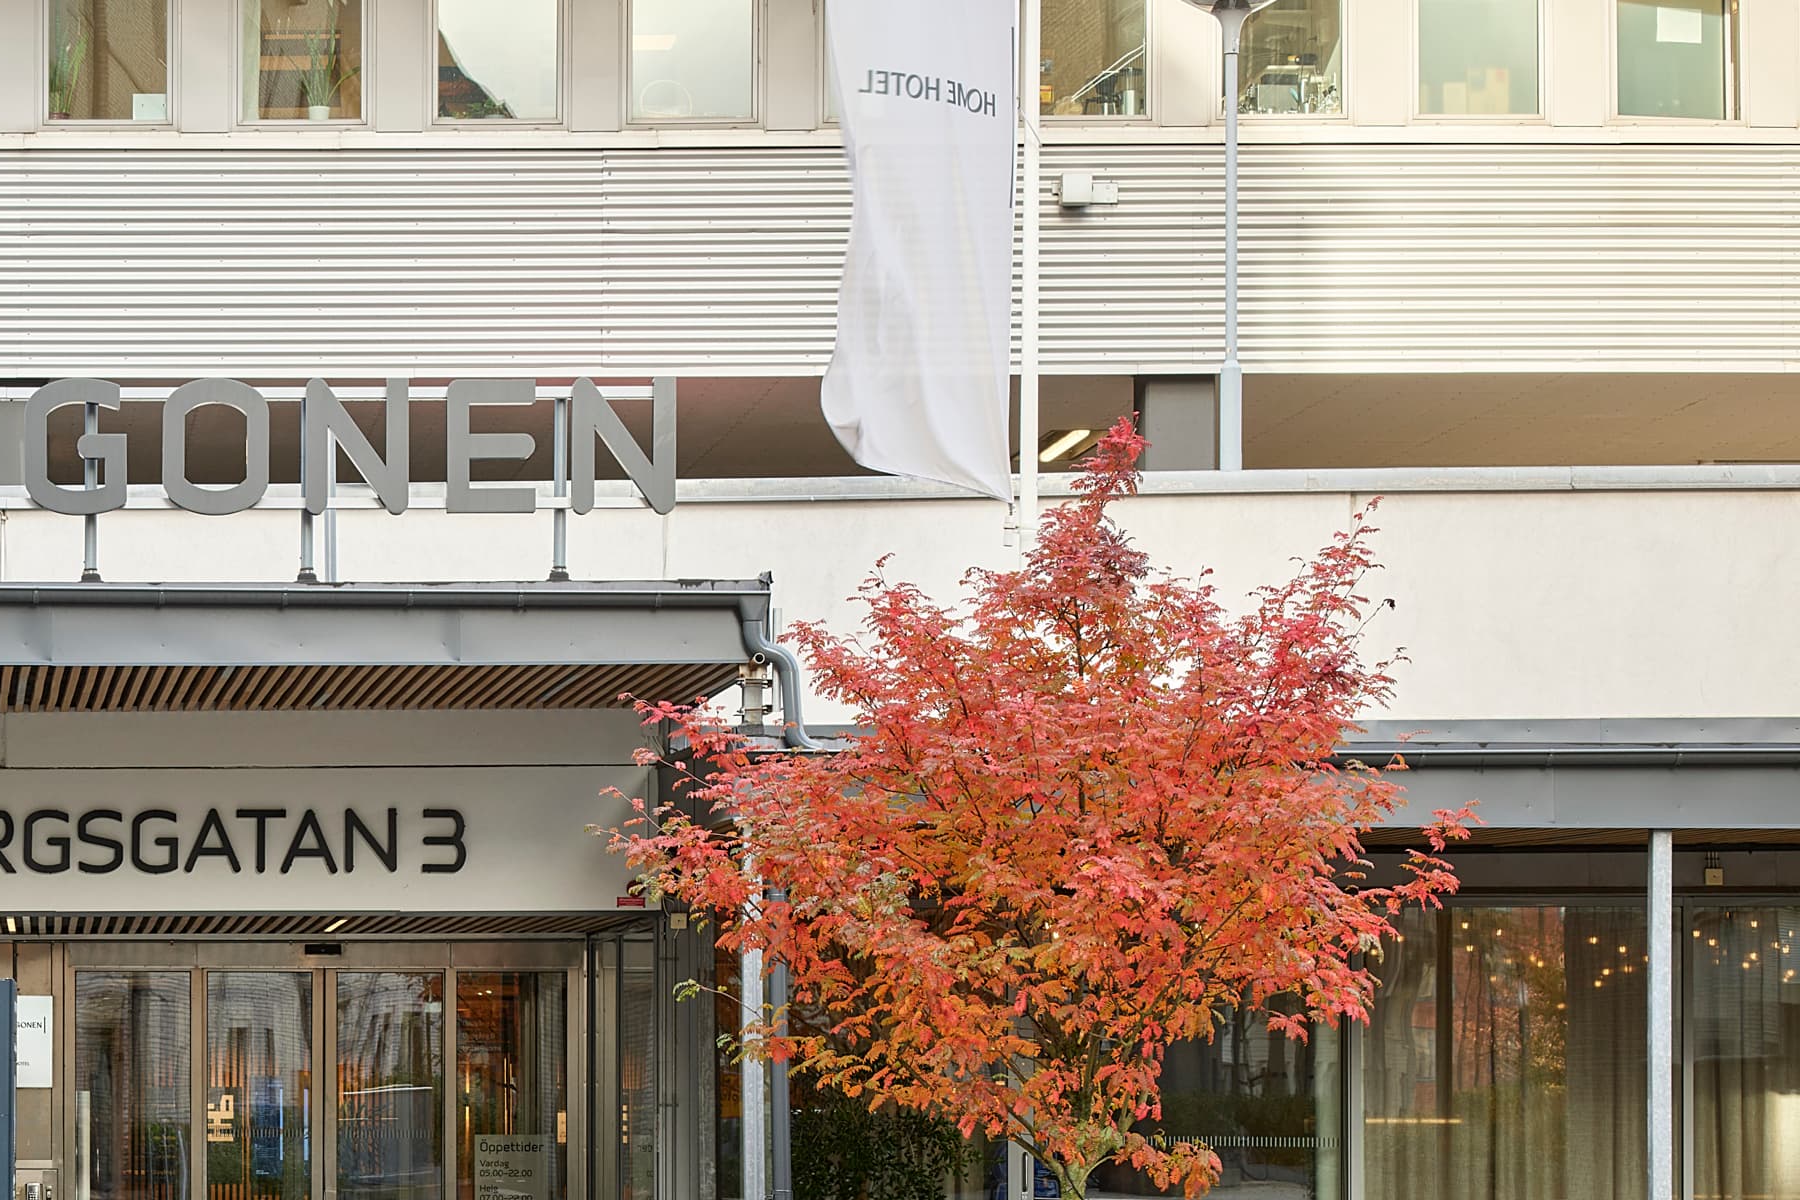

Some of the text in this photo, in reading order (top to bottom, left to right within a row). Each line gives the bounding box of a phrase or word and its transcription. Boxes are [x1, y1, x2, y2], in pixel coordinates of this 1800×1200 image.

[421, 807, 468, 874] 3
[480, 1138, 545, 1155] Öppettider
[480, 1159, 510, 1169] Vardag
